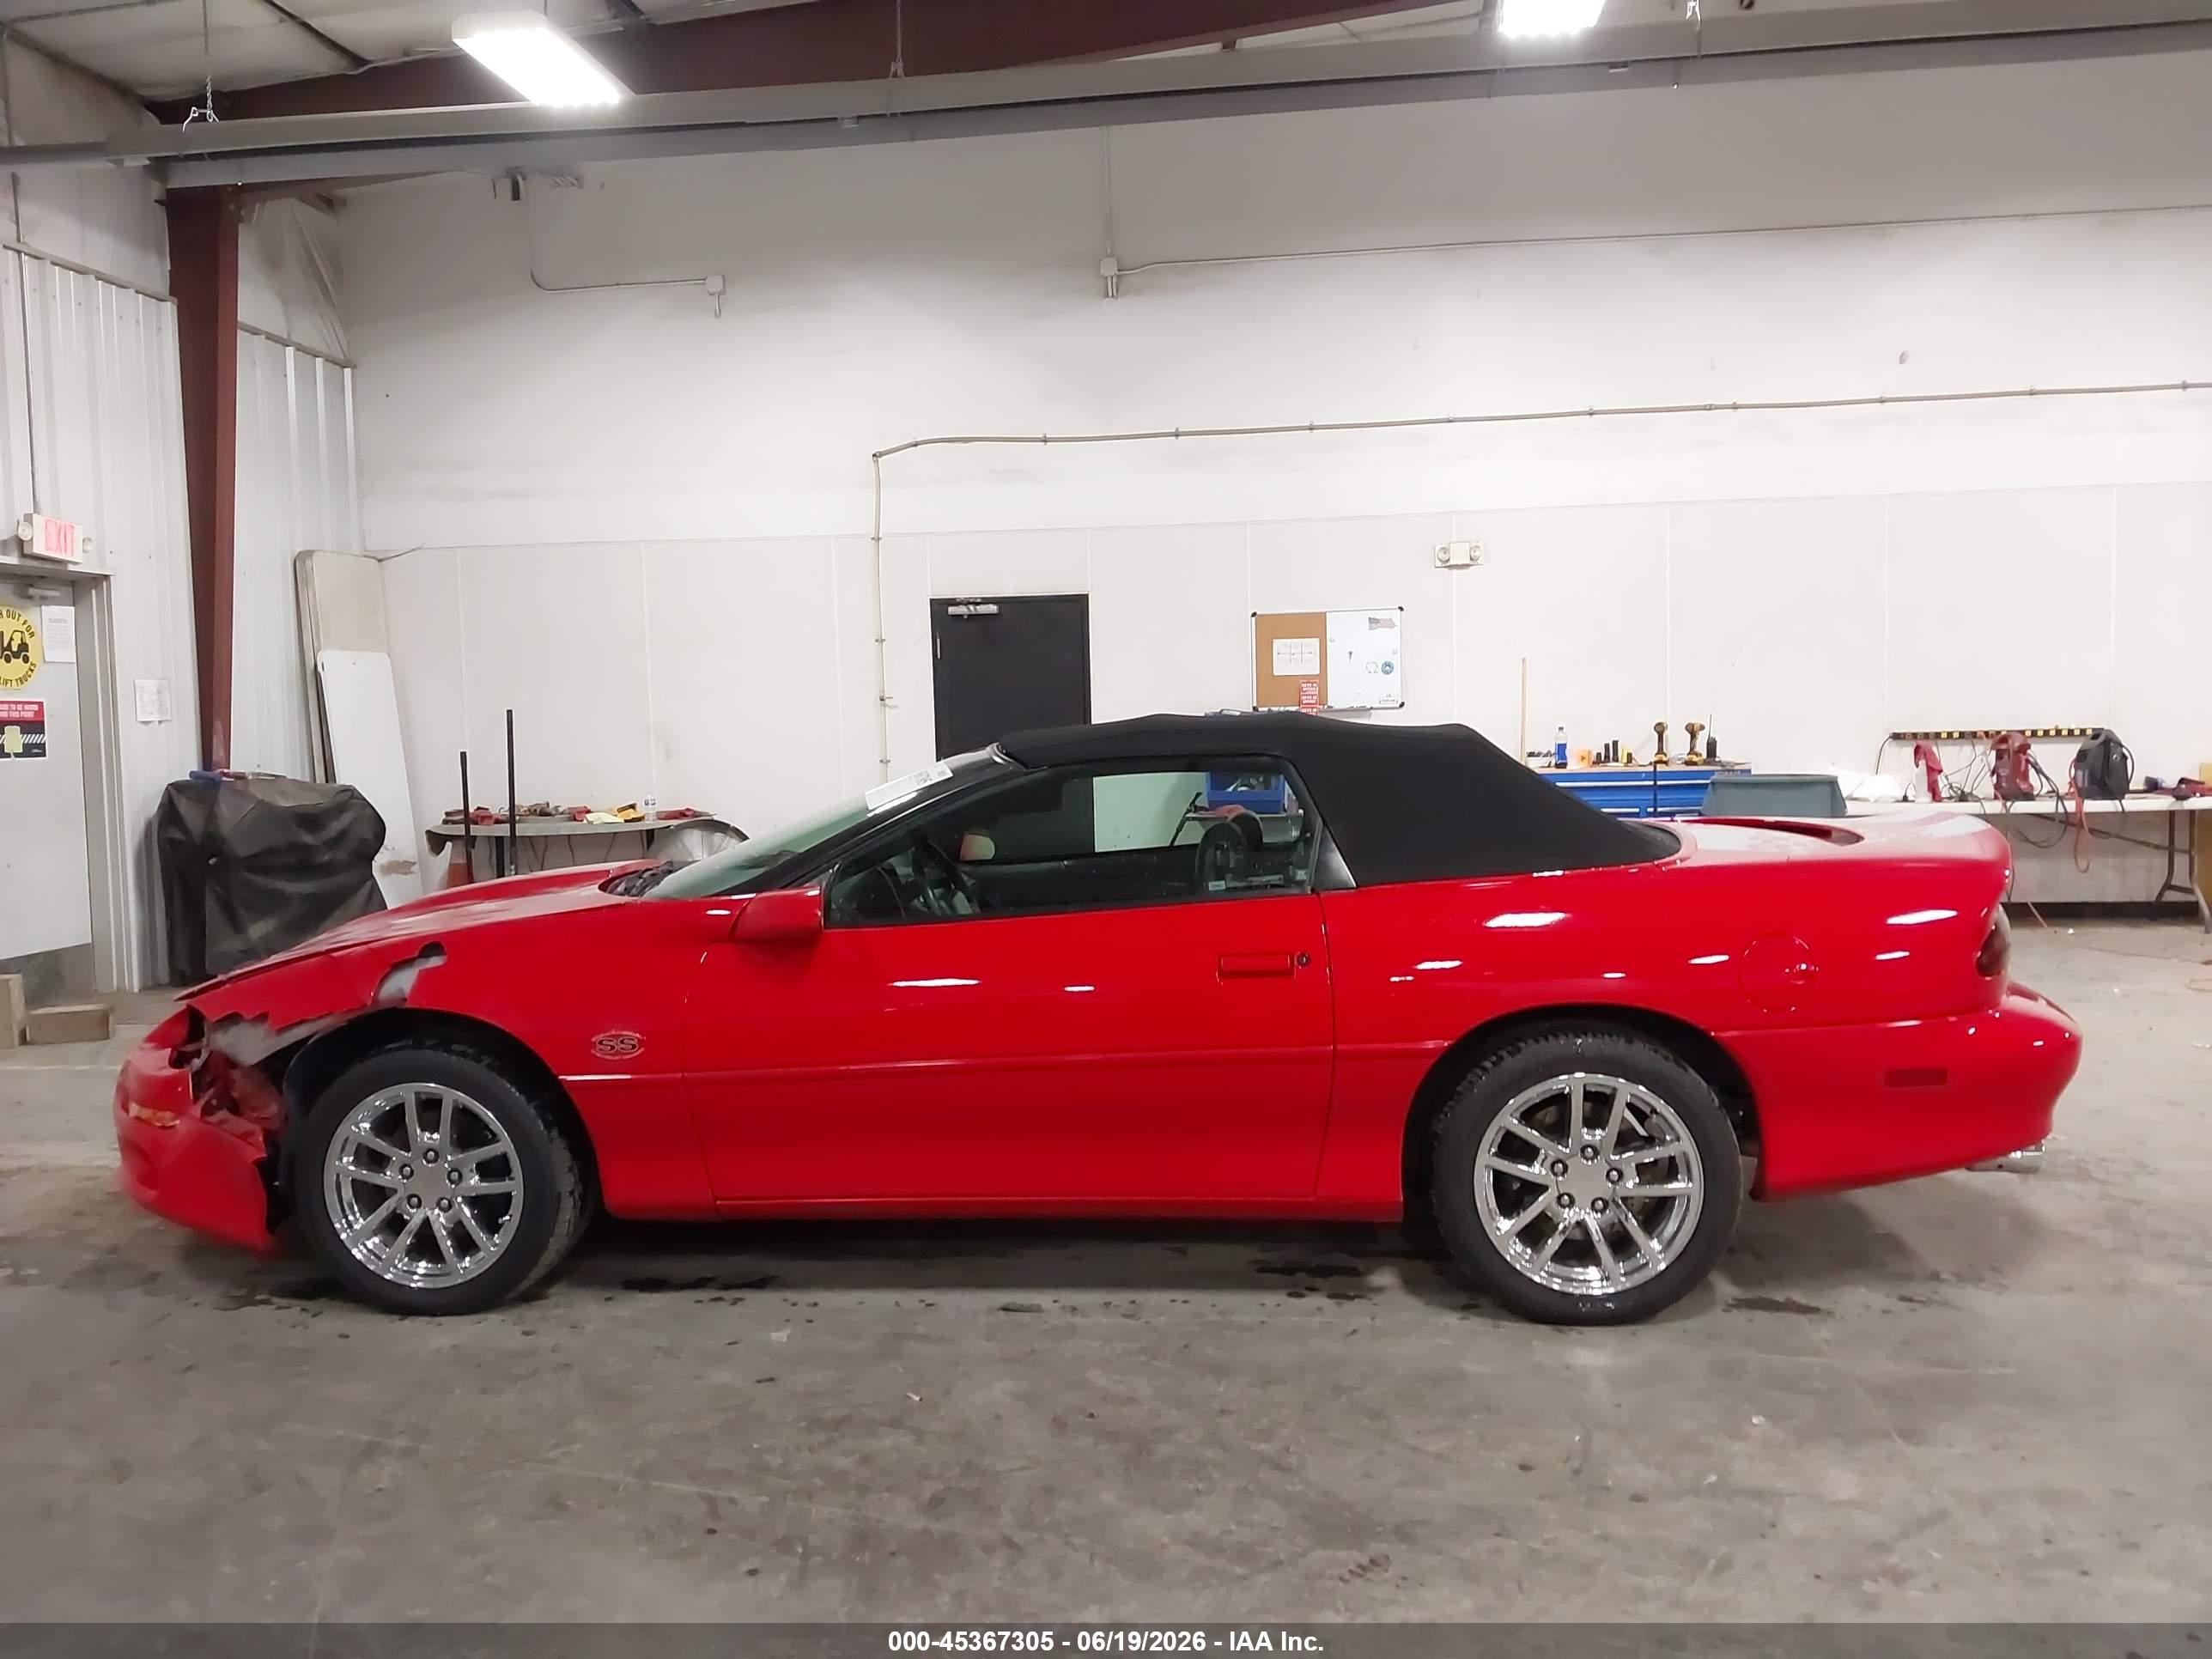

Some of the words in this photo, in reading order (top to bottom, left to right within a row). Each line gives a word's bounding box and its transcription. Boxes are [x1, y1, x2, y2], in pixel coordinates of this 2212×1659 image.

[45, 519, 75, 557] EXIT
[6, 609, 22, 622] OUT
[21, 618, 35, 639] FOR
[15, 660, 37, 688] TRUCKS
[596, 1036, 639, 1054] SS
